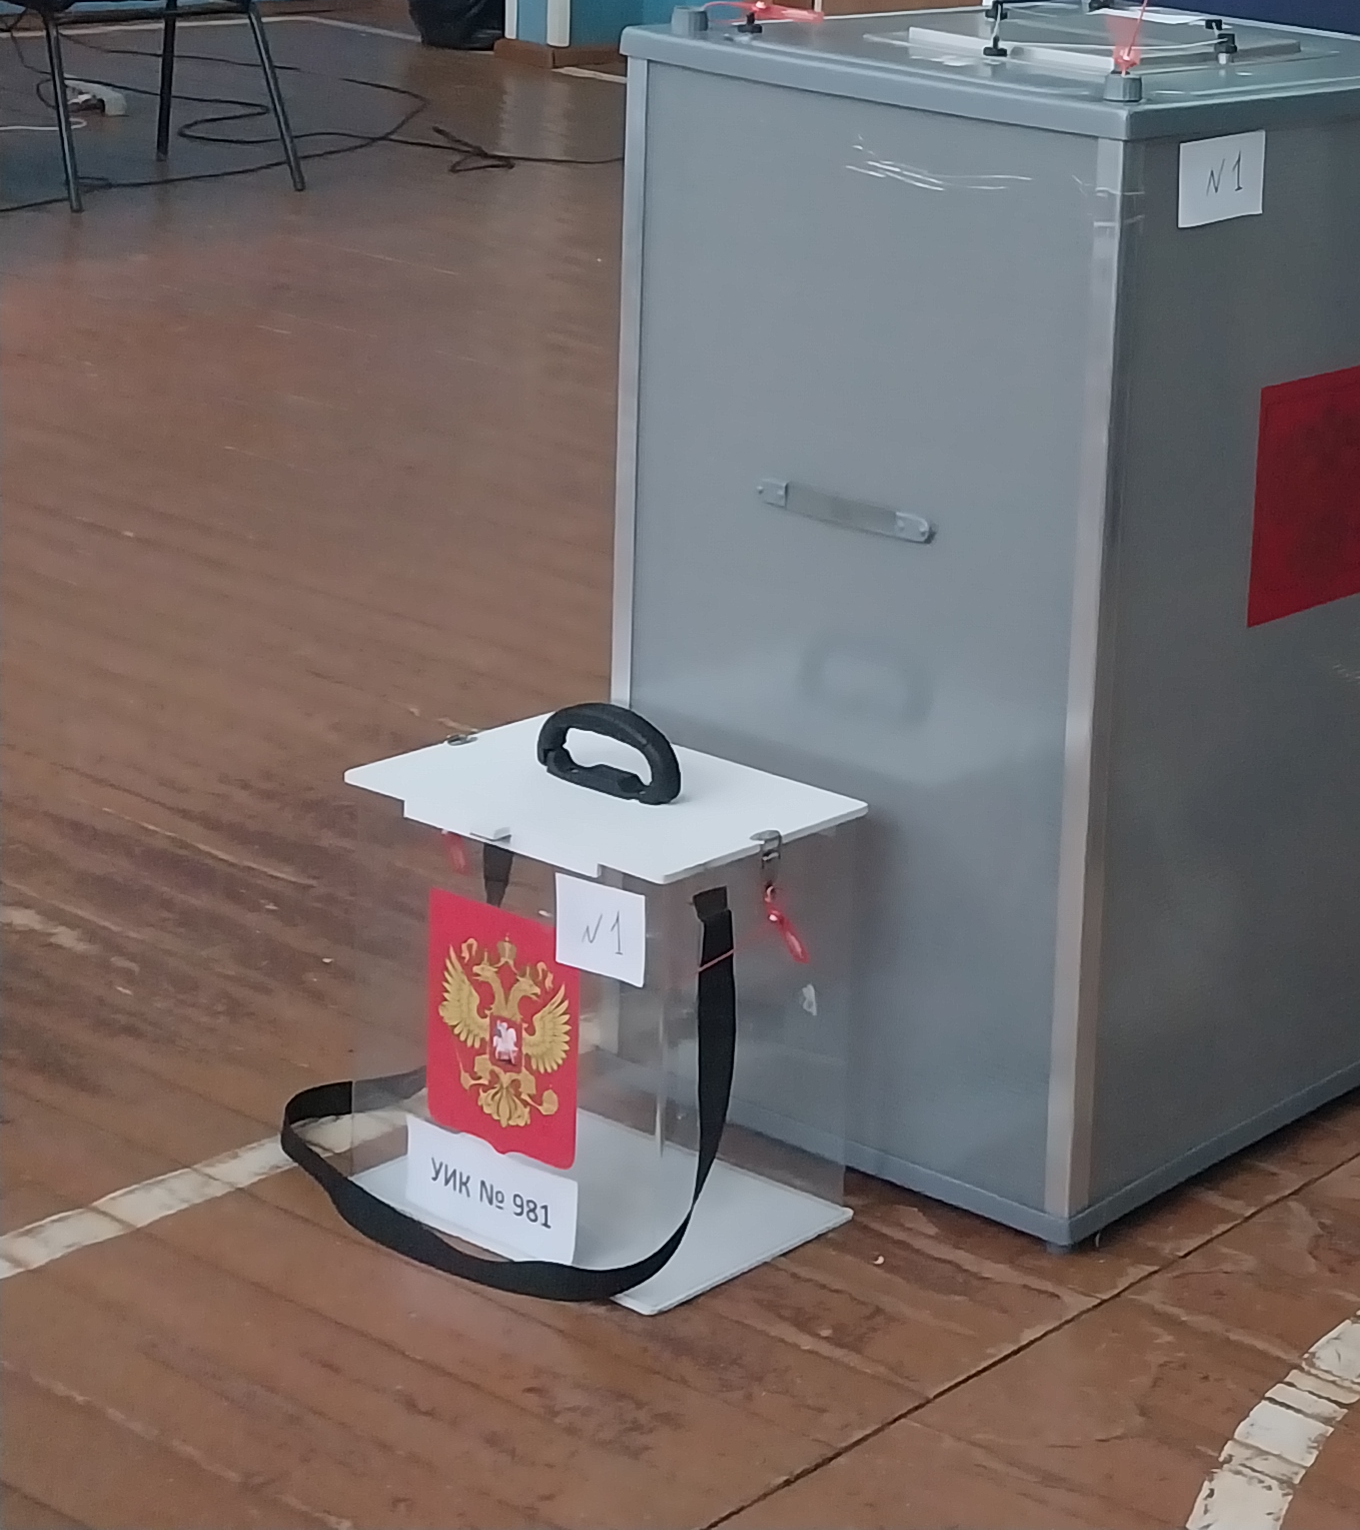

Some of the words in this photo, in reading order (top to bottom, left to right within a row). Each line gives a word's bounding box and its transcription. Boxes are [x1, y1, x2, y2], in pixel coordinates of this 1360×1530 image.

[431, 1157, 471, 1198] УИК
[479, 1179, 505, 1210] №
[512, 1193, 552, 1229] 981
